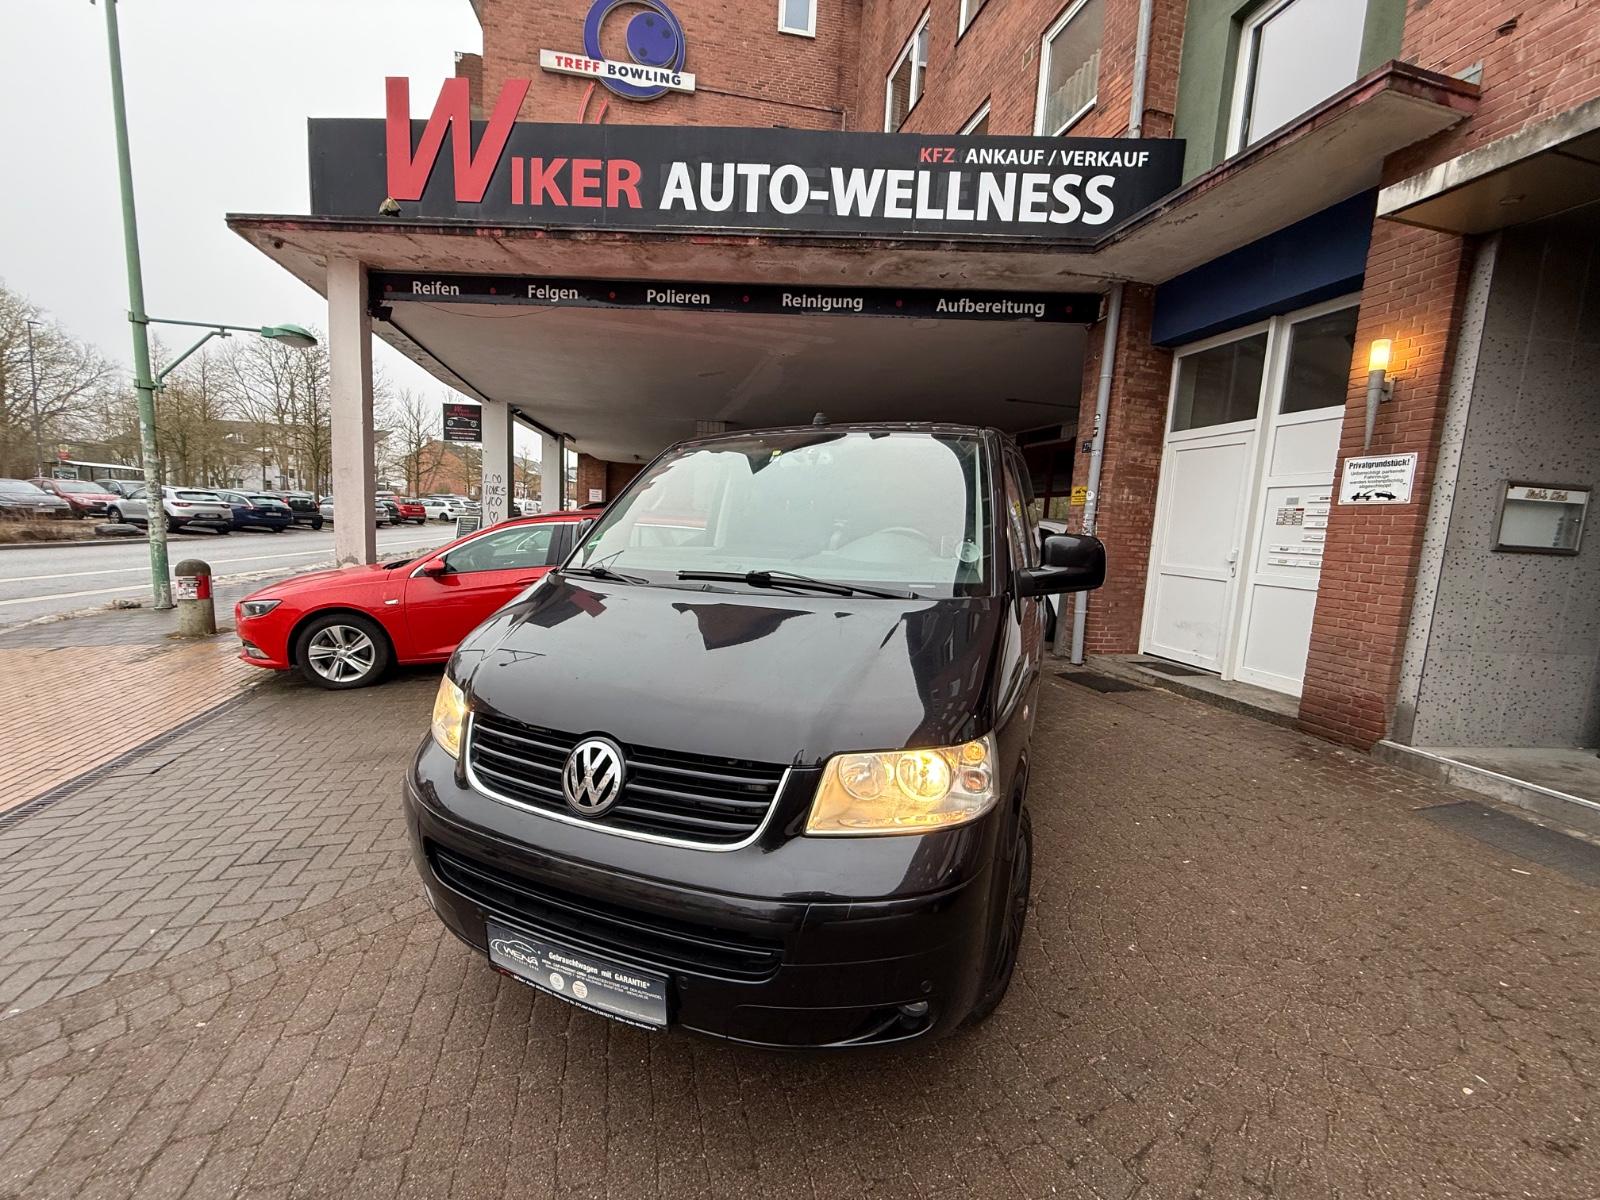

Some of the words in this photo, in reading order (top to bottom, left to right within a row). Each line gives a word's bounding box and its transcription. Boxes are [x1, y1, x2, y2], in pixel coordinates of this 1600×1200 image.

[555, 55, 600, 73] TREFF
[607, 64, 682, 86] BOWLING
[384, 76, 643, 209] WIKER
[658, 161, 1116, 226] AUTO-WELLNESS
[919, 147, 955, 163] KFZ
[965, 148, 1044, 165] ANKAUF
[1060, 150, 1150, 167] VERKAUF
[412, 280, 460, 297] Reifen
[527, 284, 579, 303] Felgen
[646, 289, 711, 305] Polieren
[781, 293, 864, 312] Reinigung
[936, 298, 1046, 318] Aufbereitung
[1348, 458, 1410, 470] Privatgrundstück!
[548, 951, 598, 975] Gebrauchtwagen
[601, 970, 612, 979] mit
